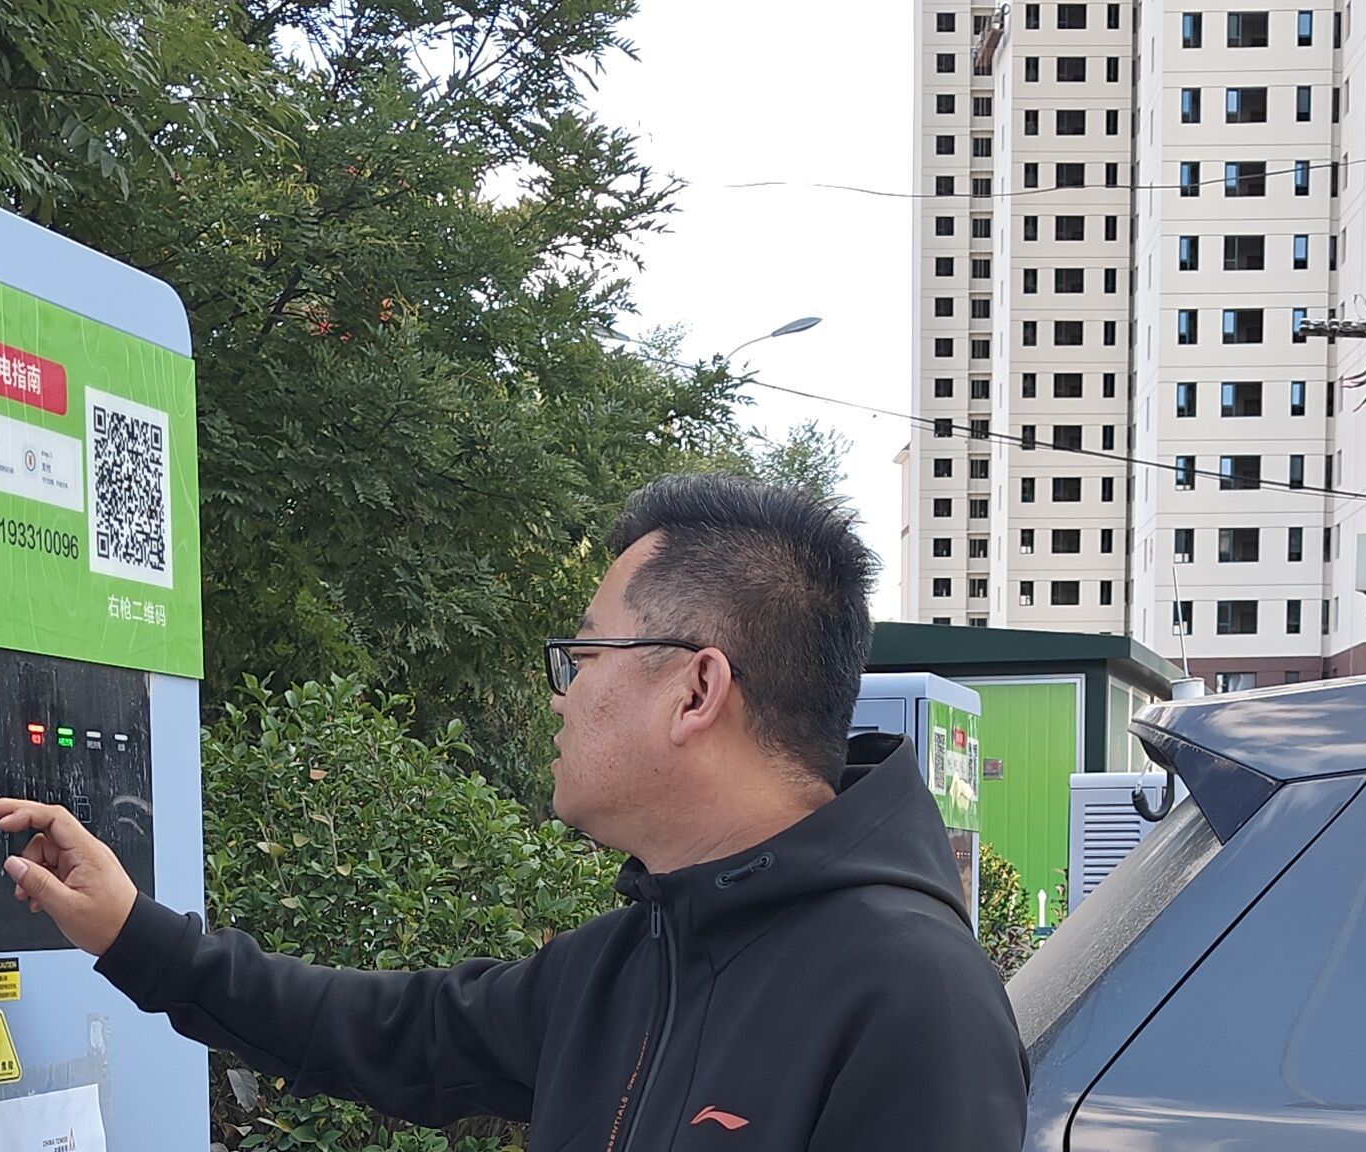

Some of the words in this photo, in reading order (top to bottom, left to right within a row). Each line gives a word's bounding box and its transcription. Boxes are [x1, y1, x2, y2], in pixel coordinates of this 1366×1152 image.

[107, 593, 166, 627] 右枪二维码
